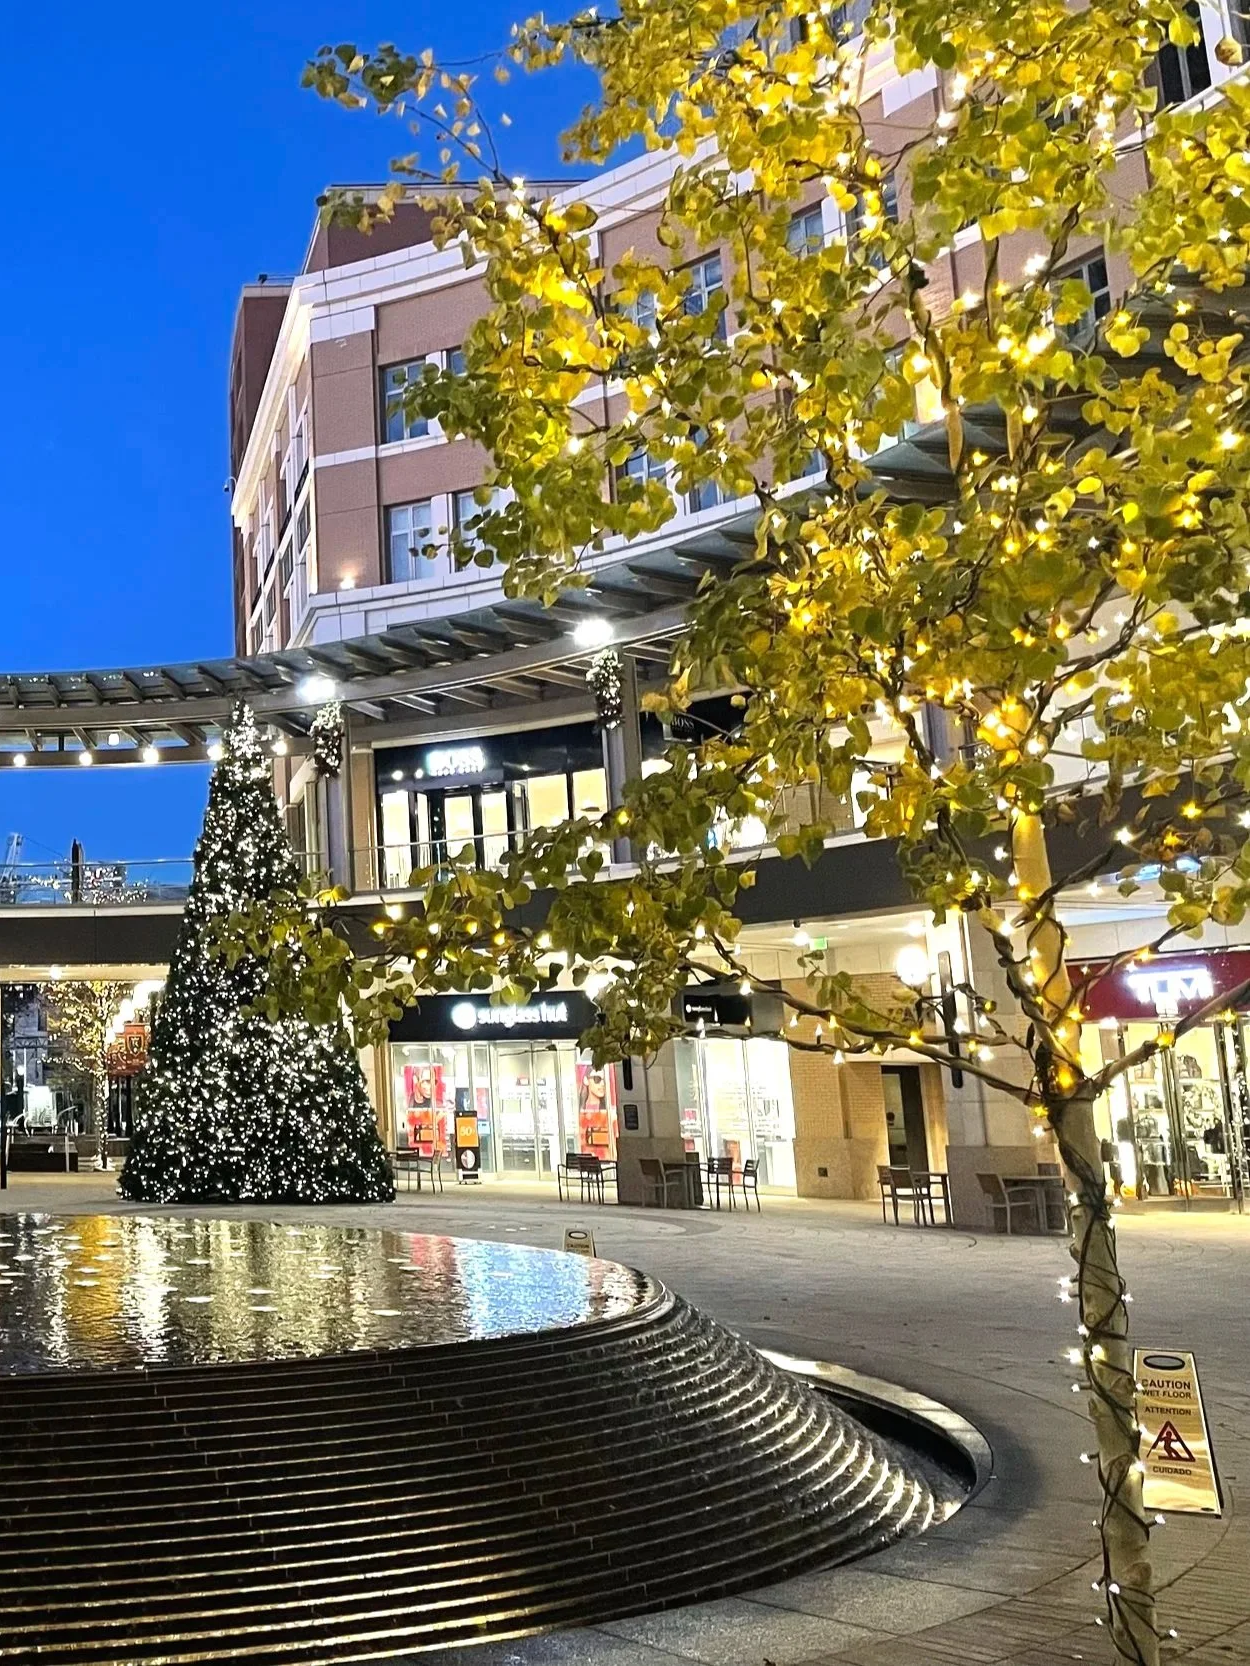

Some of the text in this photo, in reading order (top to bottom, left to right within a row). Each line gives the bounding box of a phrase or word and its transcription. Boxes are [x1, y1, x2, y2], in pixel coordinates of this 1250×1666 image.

[1141, 1379, 1191, 1390] CAUTION
[1142, 1389, 1192, 1399] WET FLOOR
[1145, 1406, 1192, 1416] ATTENTION
[1153, 1466, 1192, 1476] CUIDADO
